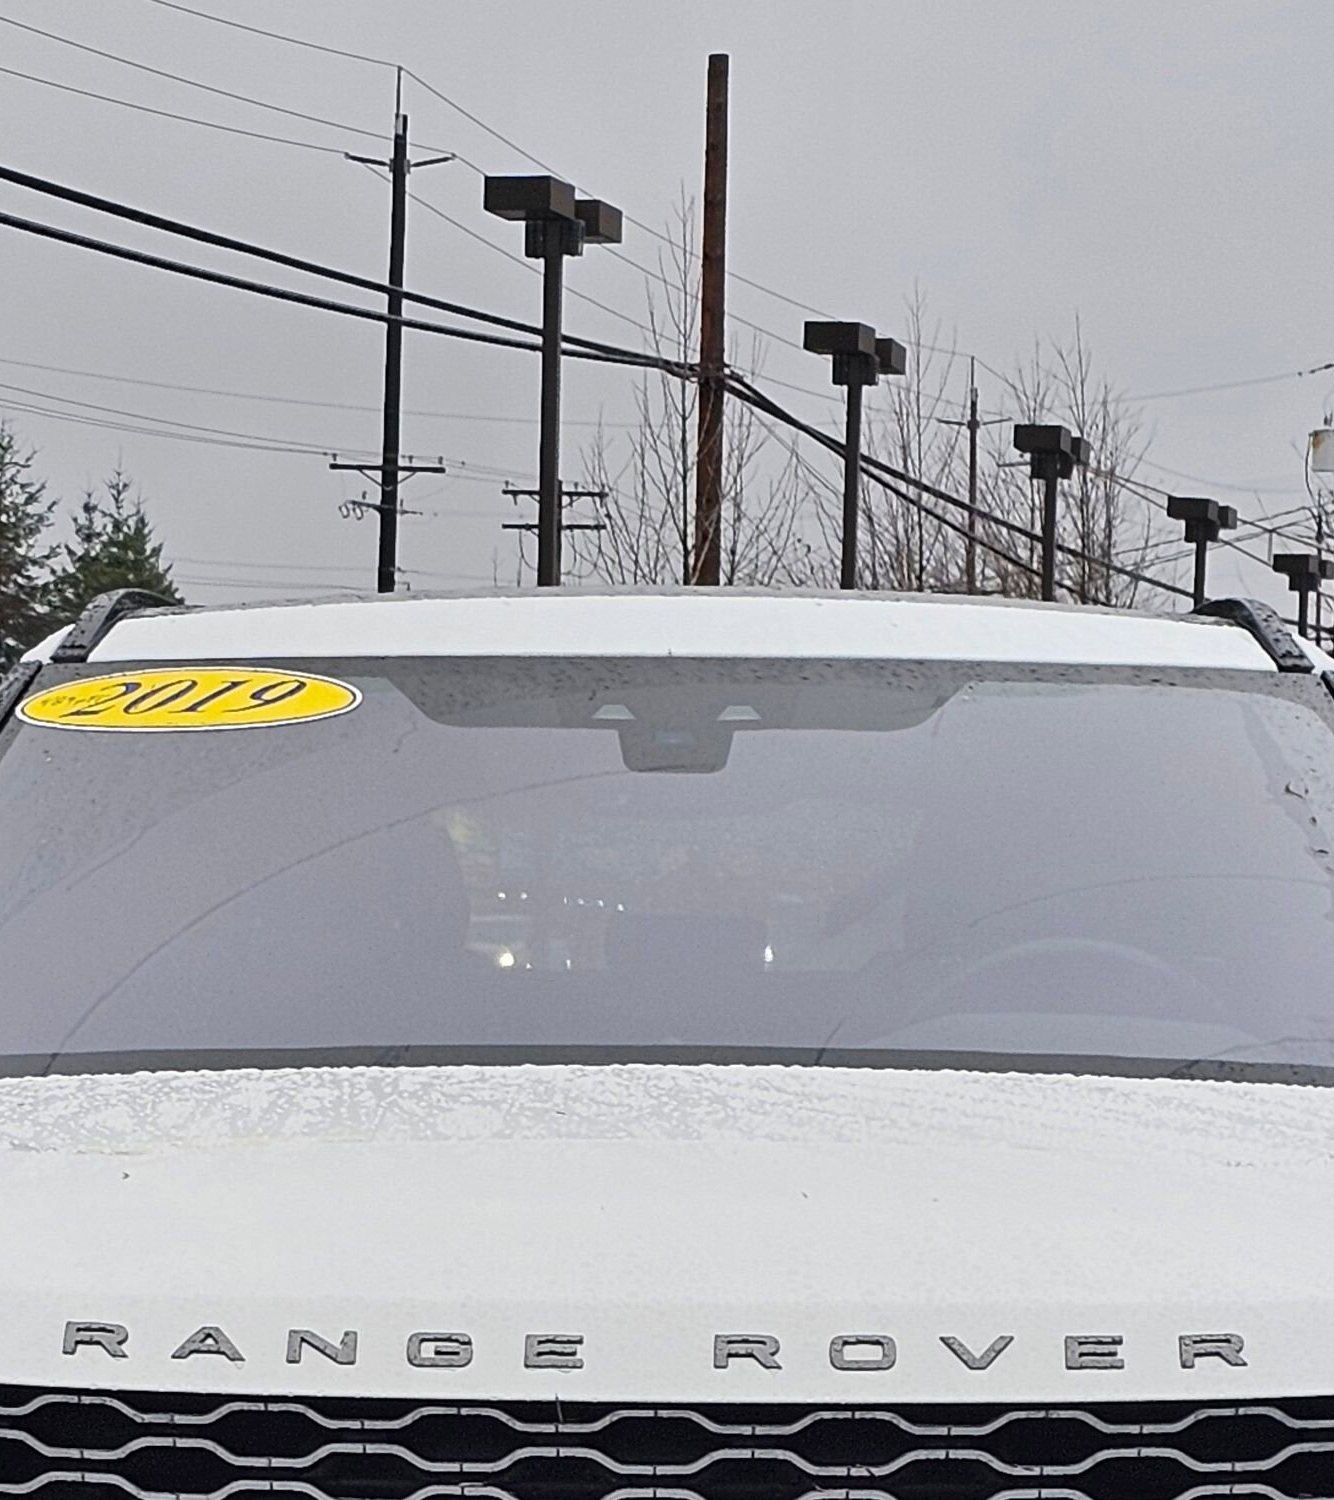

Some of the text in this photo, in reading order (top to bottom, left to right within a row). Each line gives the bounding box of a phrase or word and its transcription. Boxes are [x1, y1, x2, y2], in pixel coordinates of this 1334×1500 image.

[58, 678, 307, 719] 2019
[62, 1321, 1249, 1372] RANGE ROVER
